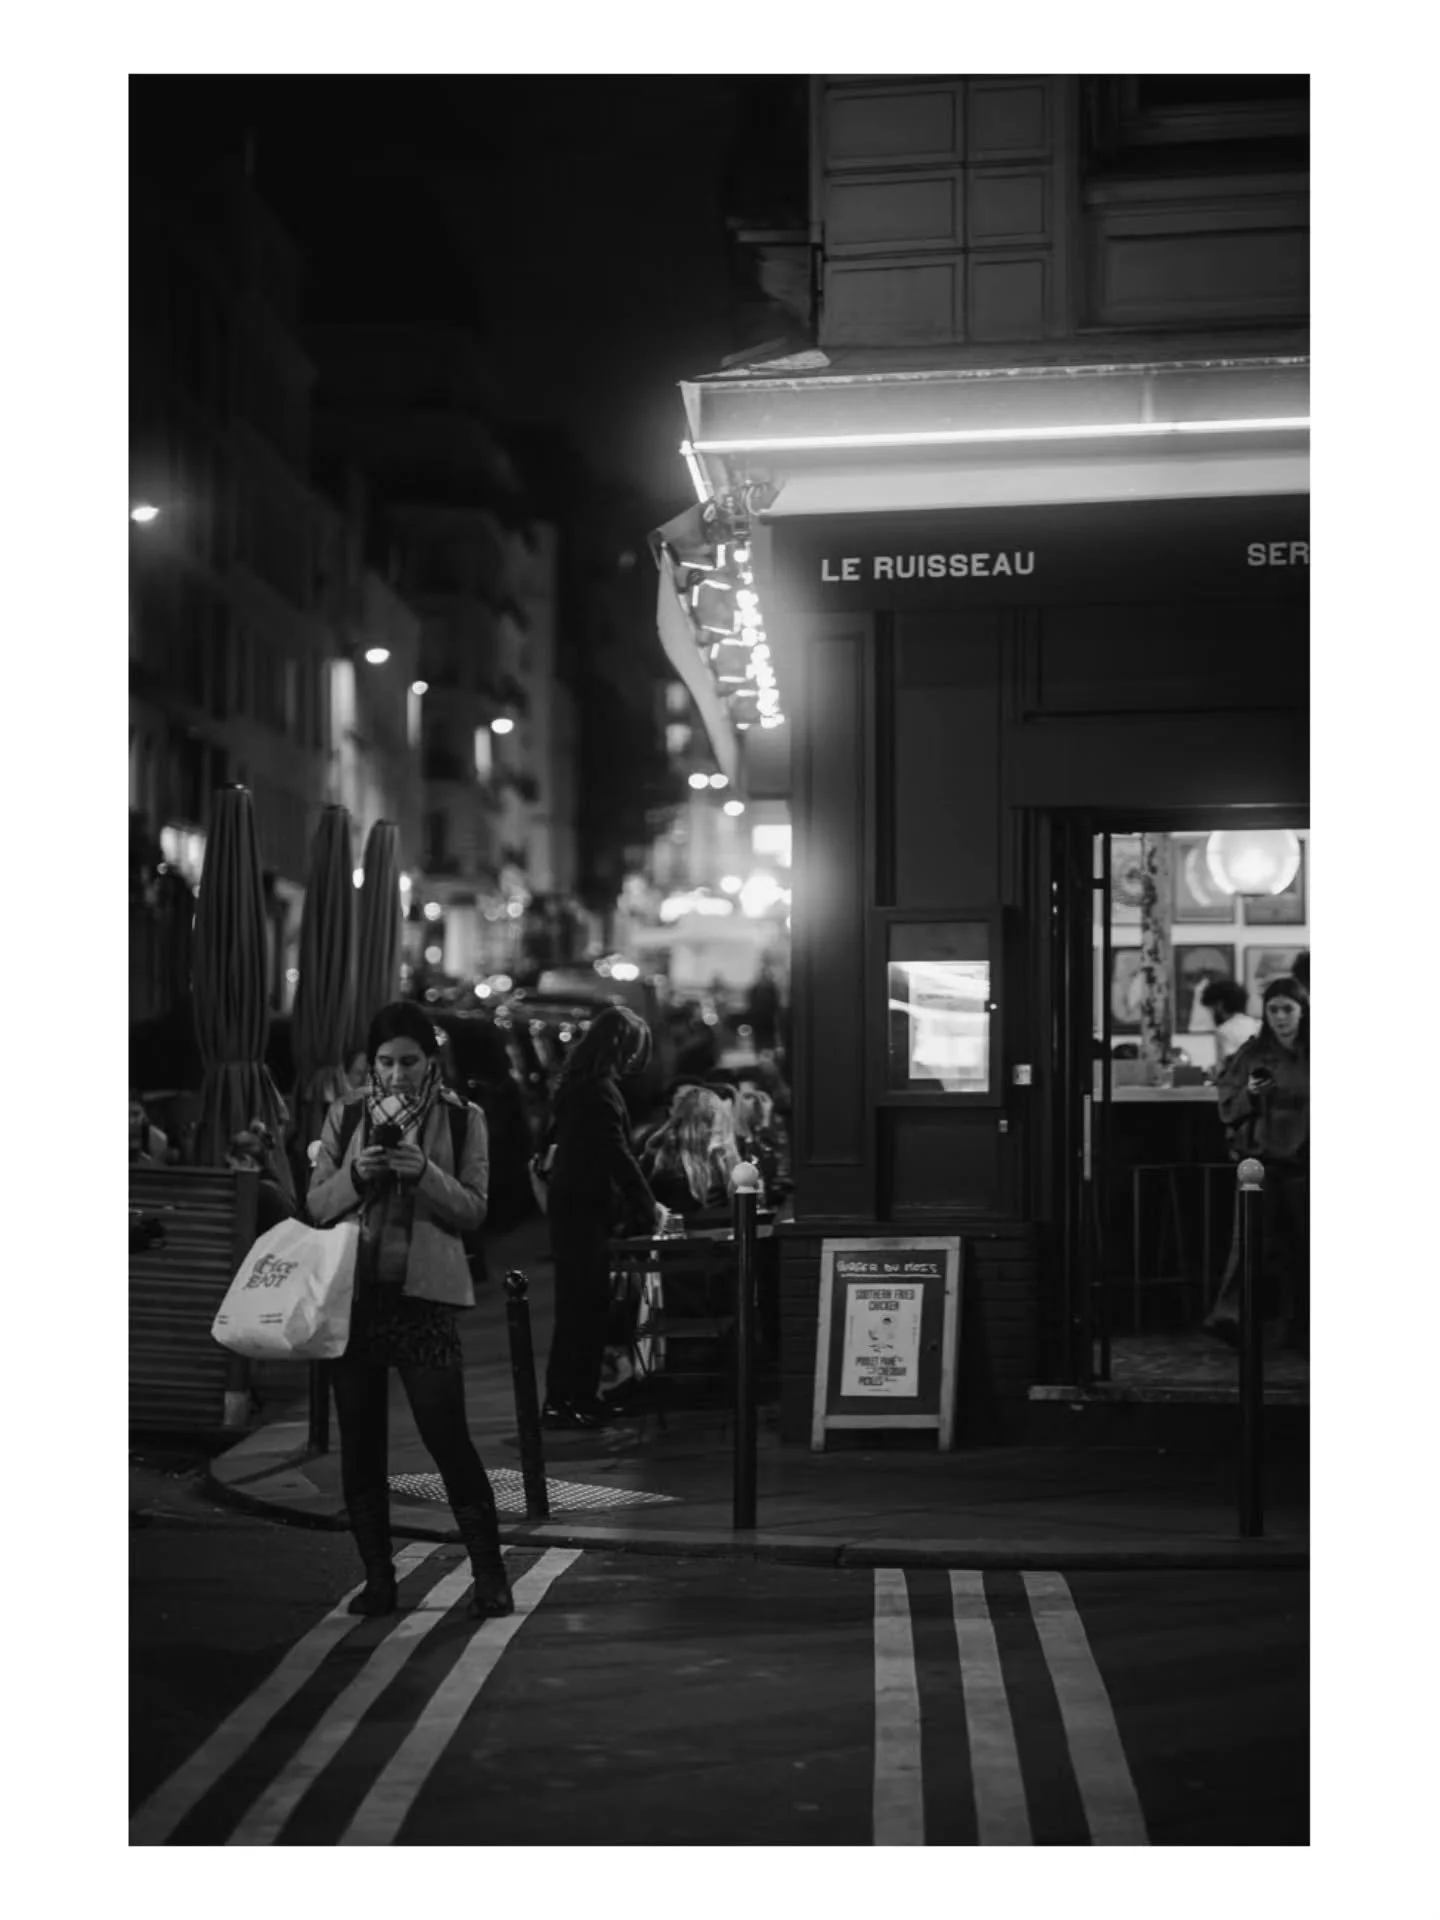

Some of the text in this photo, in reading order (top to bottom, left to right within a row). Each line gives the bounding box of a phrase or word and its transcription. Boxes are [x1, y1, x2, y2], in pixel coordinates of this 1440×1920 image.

[822, 551, 1036, 582] LE RUISSEAU
[1247, 541, 1310, 567] SER
